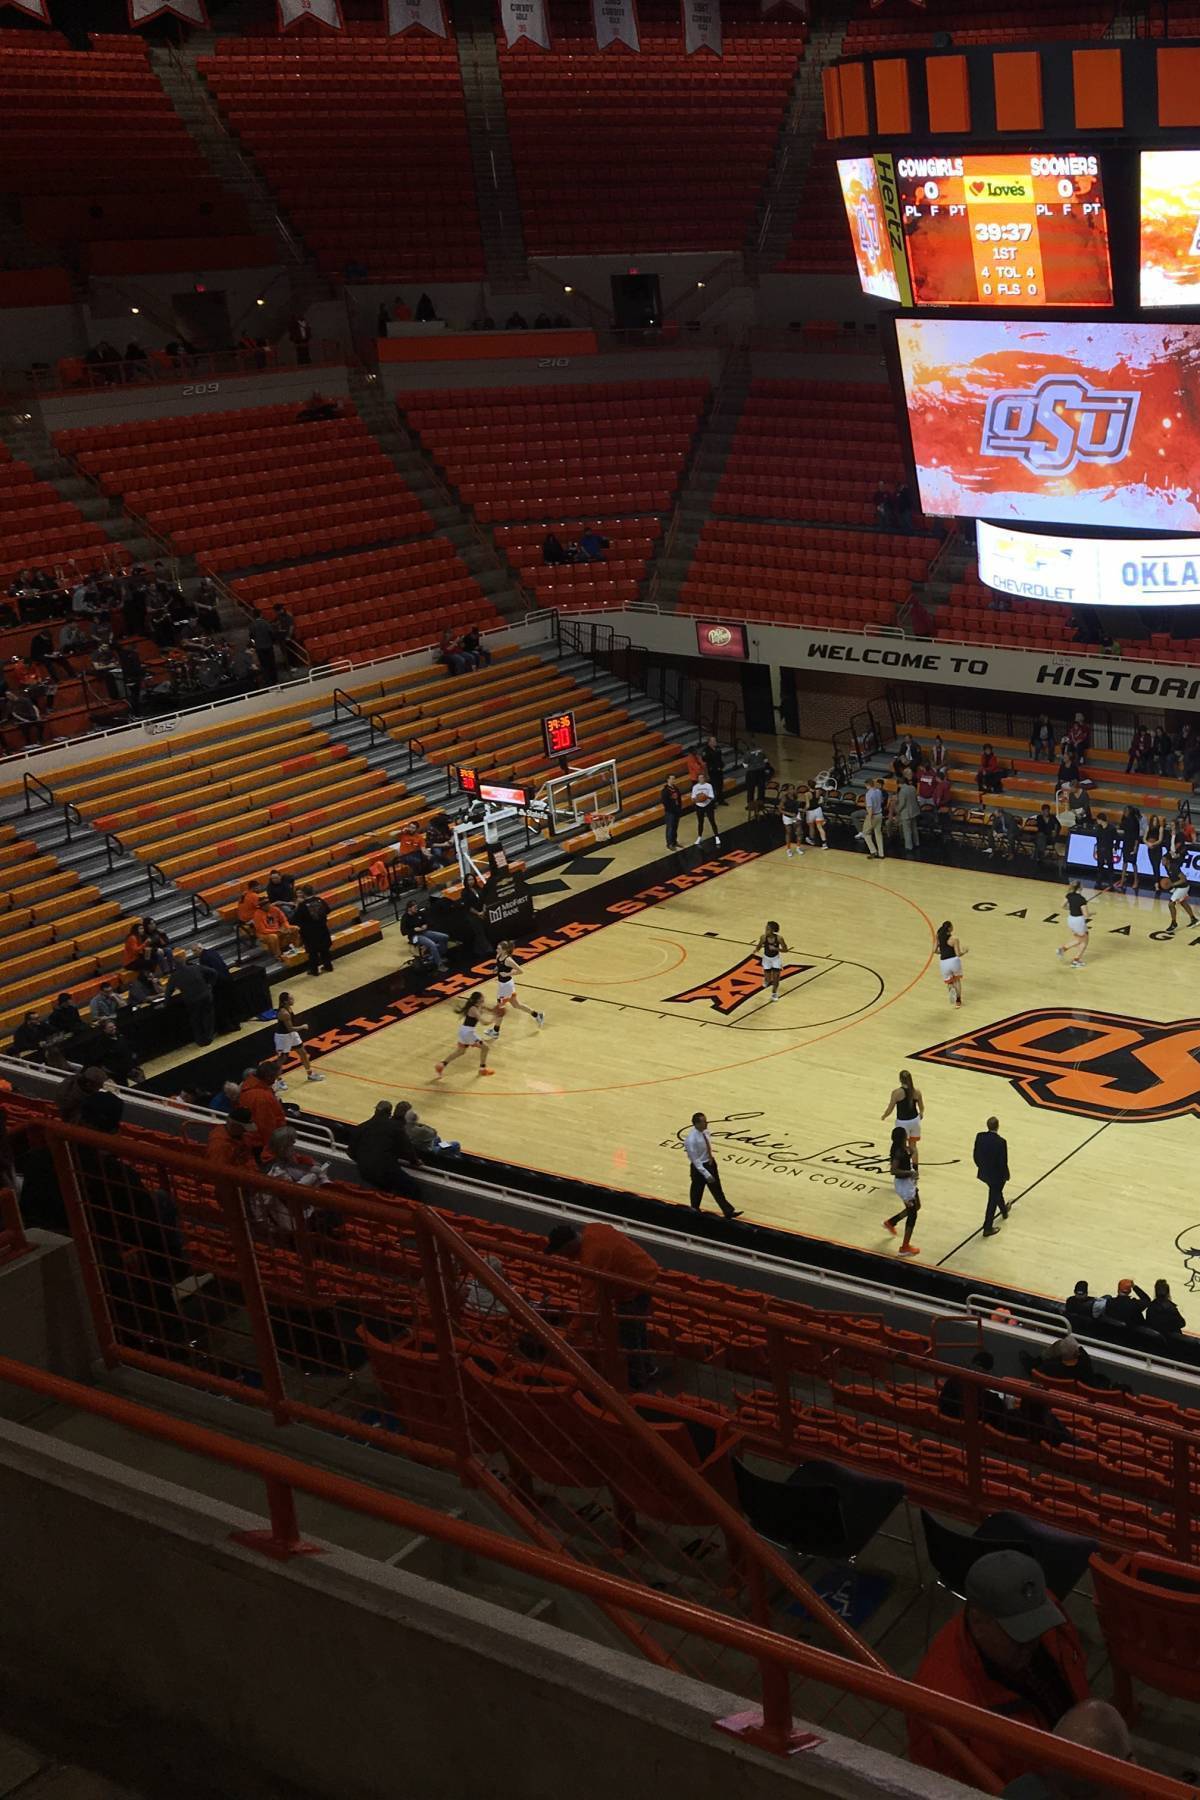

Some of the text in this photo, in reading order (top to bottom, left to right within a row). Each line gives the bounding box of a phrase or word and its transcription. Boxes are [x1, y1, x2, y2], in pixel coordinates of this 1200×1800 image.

[898, 158, 964, 177] COWGIRLS
[1030, 156, 1098, 176] SOONERS
[923, 181, 939, 200] 0
[1057, 179, 1073, 199] 0
[878, 160, 903, 252] Hertz
[905, 204, 966, 217] PL F PT
[1036, 203, 1101, 216] PL F PT
[974, 223, 1033, 242] 39:37
[992, 247, 1018, 260] 1ST
[981, 267, 990, 279] 4
[1025, 266, 1035, 279] 4
[982, 283, 1037, 296] 0 FLS 0
[183, 381, 219, 397] 209
[980, 374, 1142, 476] OSU
[993, 574, 1075, 601] CHEVROLET
[808, 643, 939, 672] WELCOME
[952, 655, 989, 676] TO
[551, 727, 571, 751] 30
[605, 849, 762, 914] STATE
[722, 1153, 880, 1195] SUTTON COURT
